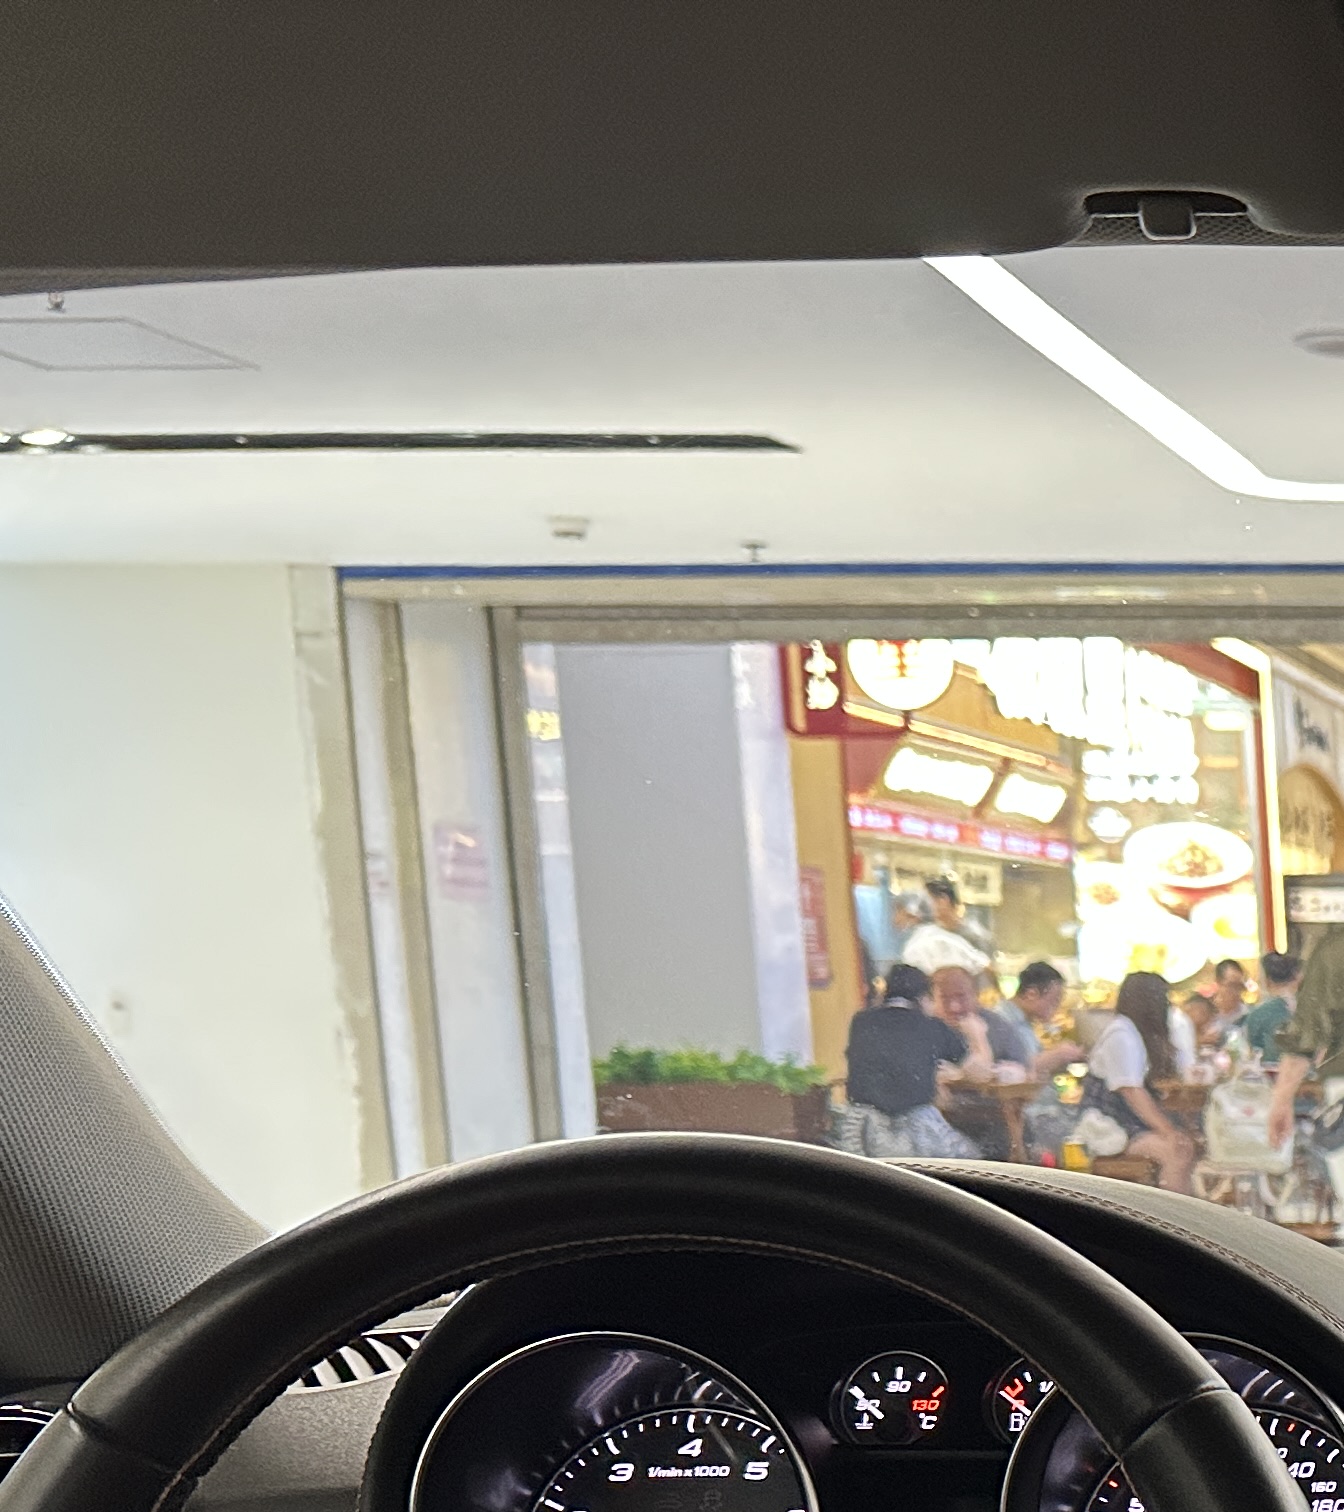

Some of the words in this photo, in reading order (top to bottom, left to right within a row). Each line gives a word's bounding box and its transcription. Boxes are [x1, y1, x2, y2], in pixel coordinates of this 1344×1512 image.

[886, 1381, 912, 1393] 90
[912, 1400, 940, 1411] 130
[678, 1438, 703, 1457] 4
[608, 1463, 635, 1482] 3
[743, 1462, 770, 1480] 5
[1310, 1481, 1337, 1493] 160
